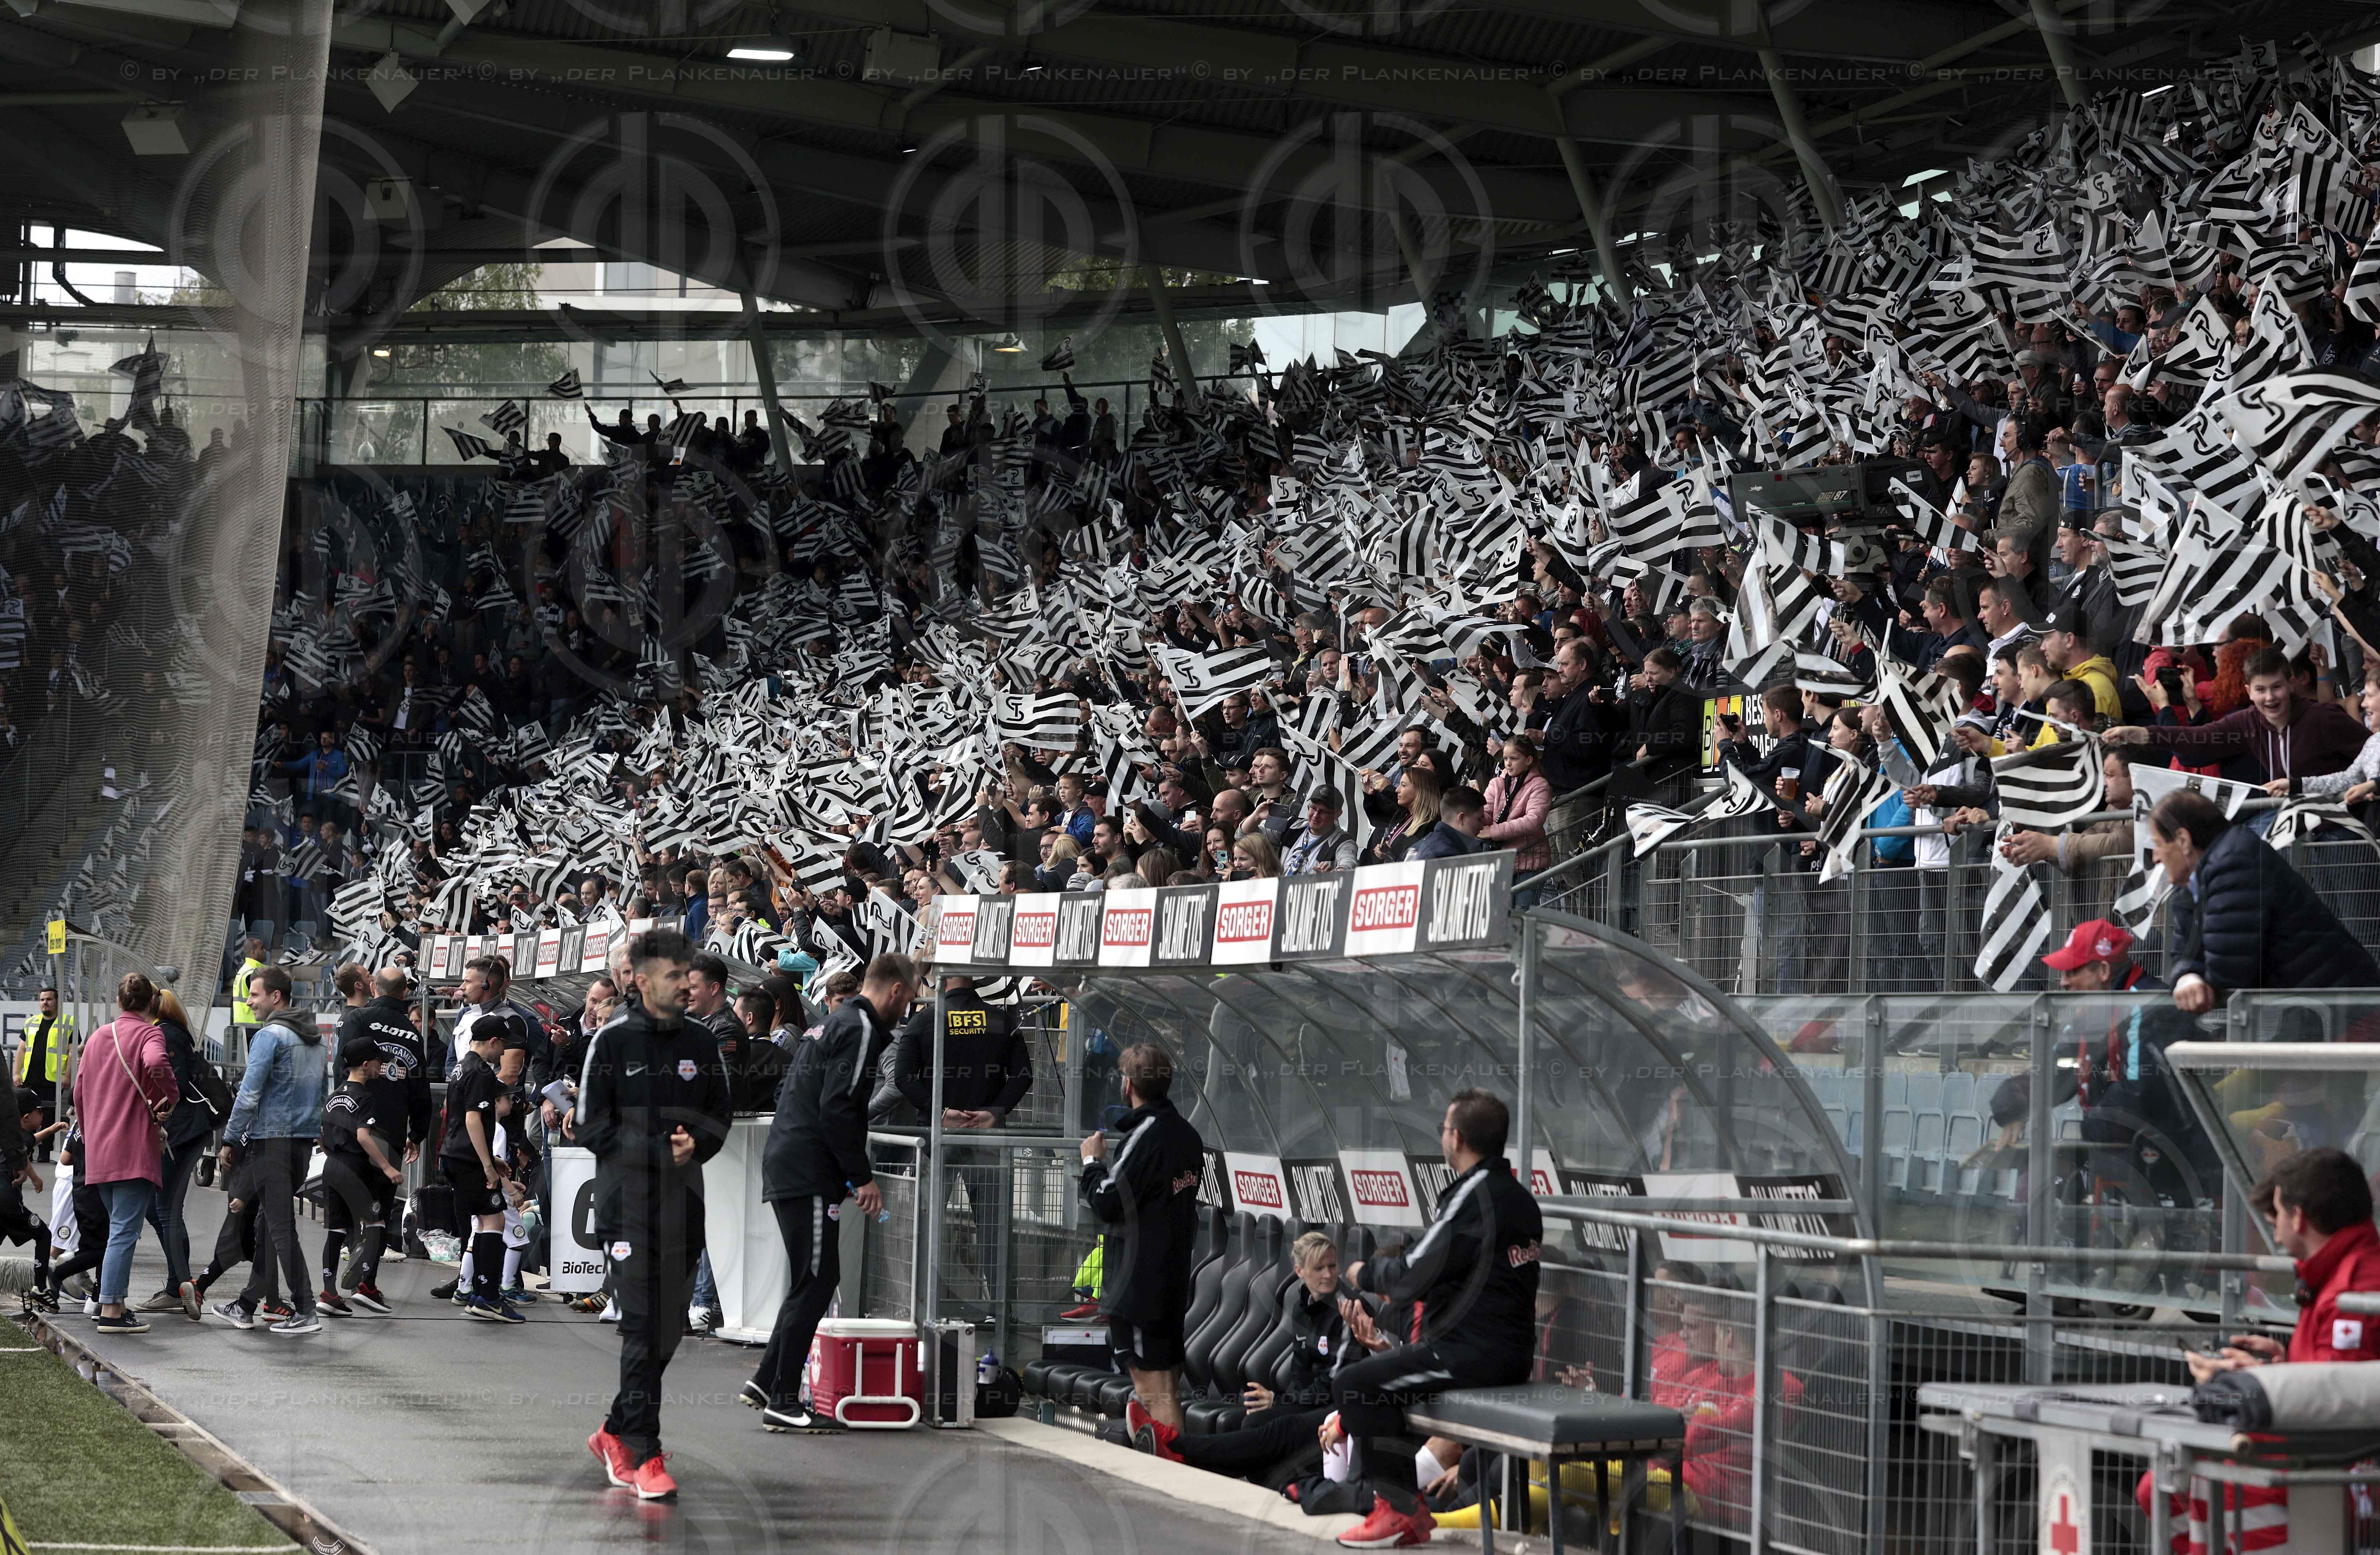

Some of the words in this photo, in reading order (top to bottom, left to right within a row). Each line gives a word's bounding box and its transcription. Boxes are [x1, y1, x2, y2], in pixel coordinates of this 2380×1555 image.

[941, 916, 973, 942] SORGER
[1016, 916, 1052, 944] SORGER
[1106, 912, 1149, 943] SORGER
[1220, 904, 1269, 939] SORGER
[1355, 889, 1415, 927] SORGER
[434, 949, 446, 966] SORGER
[538, 944, 558, 964] SORGER
[585, 936, 607, 957] SORGER
[953, 1015, 981, 1027] BFS
[1237, 1174, 1280, 1205] SORGER
[1354, 1174, 1406, 1203] SORGER
[562, 1262, 606, 1274] BioTec
